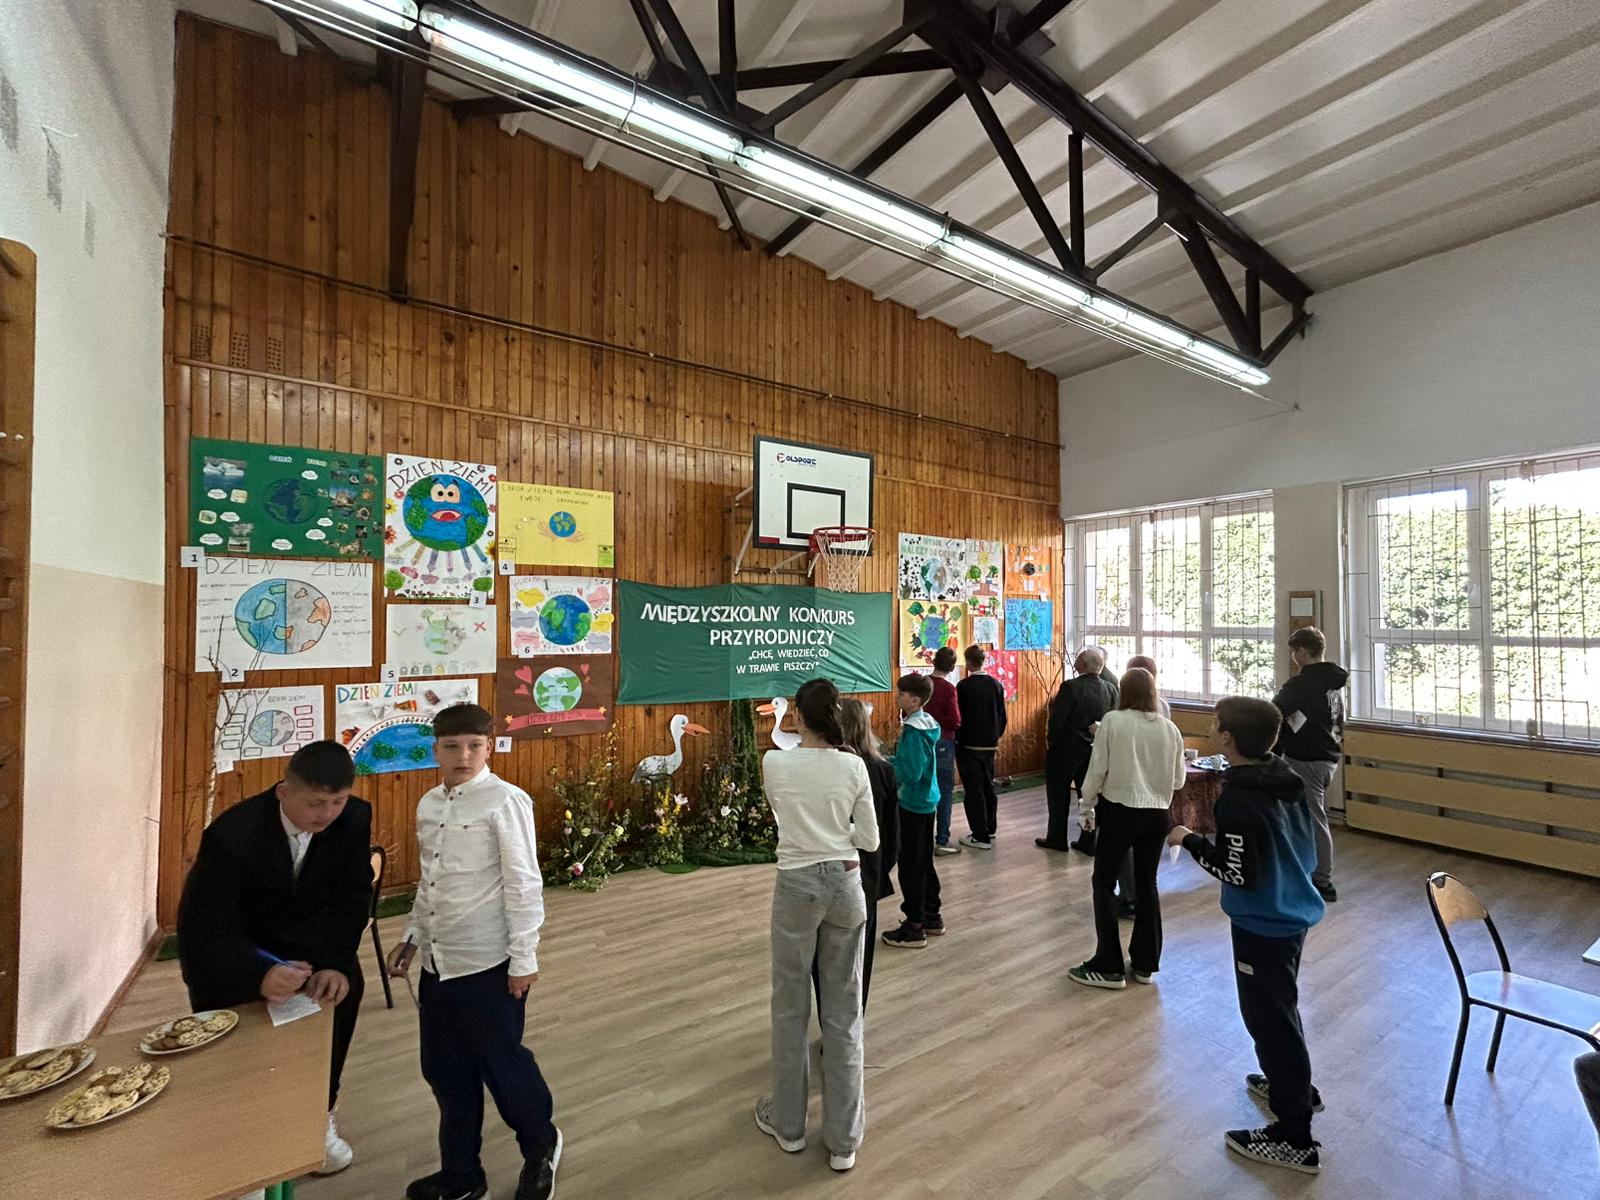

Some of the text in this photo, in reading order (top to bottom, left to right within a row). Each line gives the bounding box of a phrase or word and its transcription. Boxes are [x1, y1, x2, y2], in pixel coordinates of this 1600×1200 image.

[448, 461, 493, 496] ZIEMI
[191, 554, 198, 562] 1
[312, 562, 368, 577] ZIEMI
[502, 563, 509, 571] 4
[640, 602, 856, 625] MIĘDZYSZKOLNY KONKURS
[709, 629, 835, 646] PRZYRODNICZY
[524, 646, 530, 654] 6
[231, 668, 239, 677] 2
[736, 664, 746, 674] W
[748, 663, 779, 673] TRAWIE
[388, 670, 394, 678] 5
[383, 682, 417, 698] ZIEMI
[499, 740, 505, 748] 8
